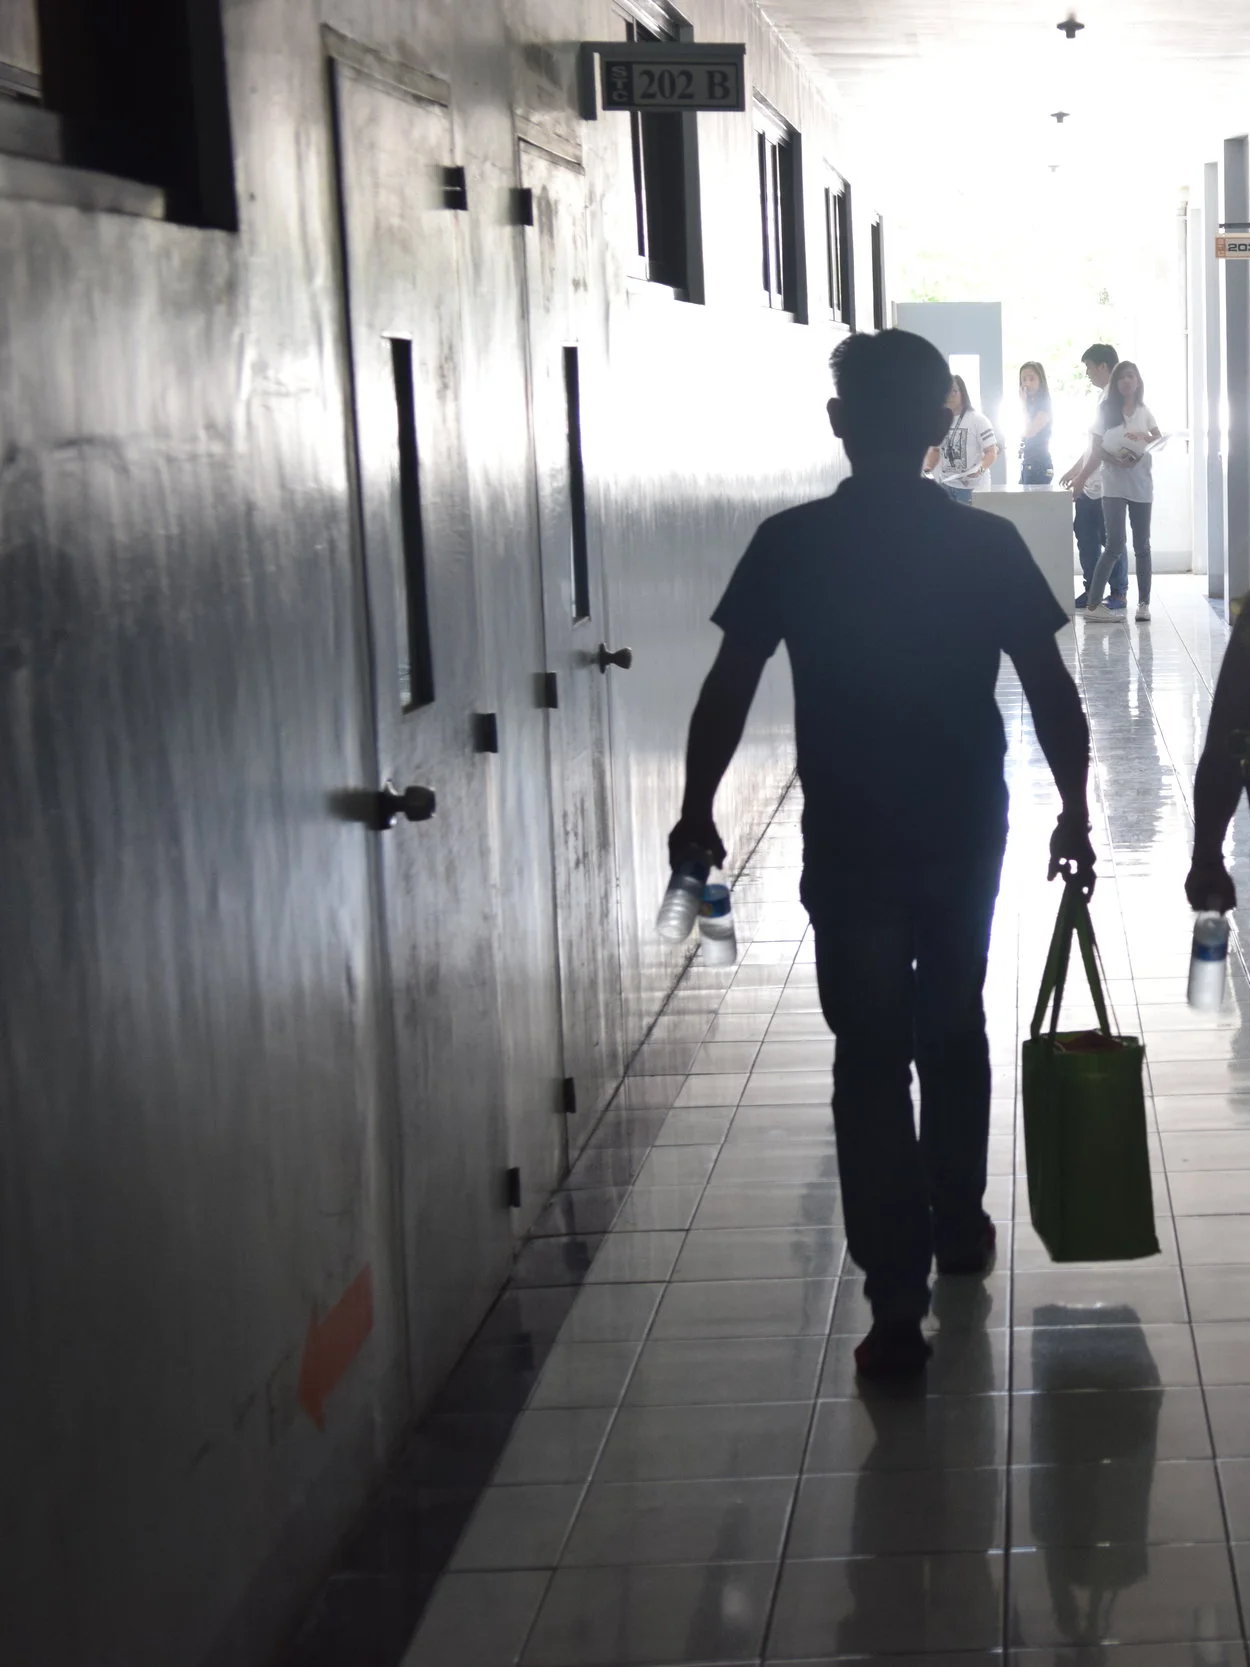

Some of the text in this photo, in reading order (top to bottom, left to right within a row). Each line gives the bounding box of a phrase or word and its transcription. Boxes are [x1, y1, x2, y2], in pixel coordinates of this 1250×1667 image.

[611, 65, 630, 102] STC
[638, 69, 731, 100] 202 B
